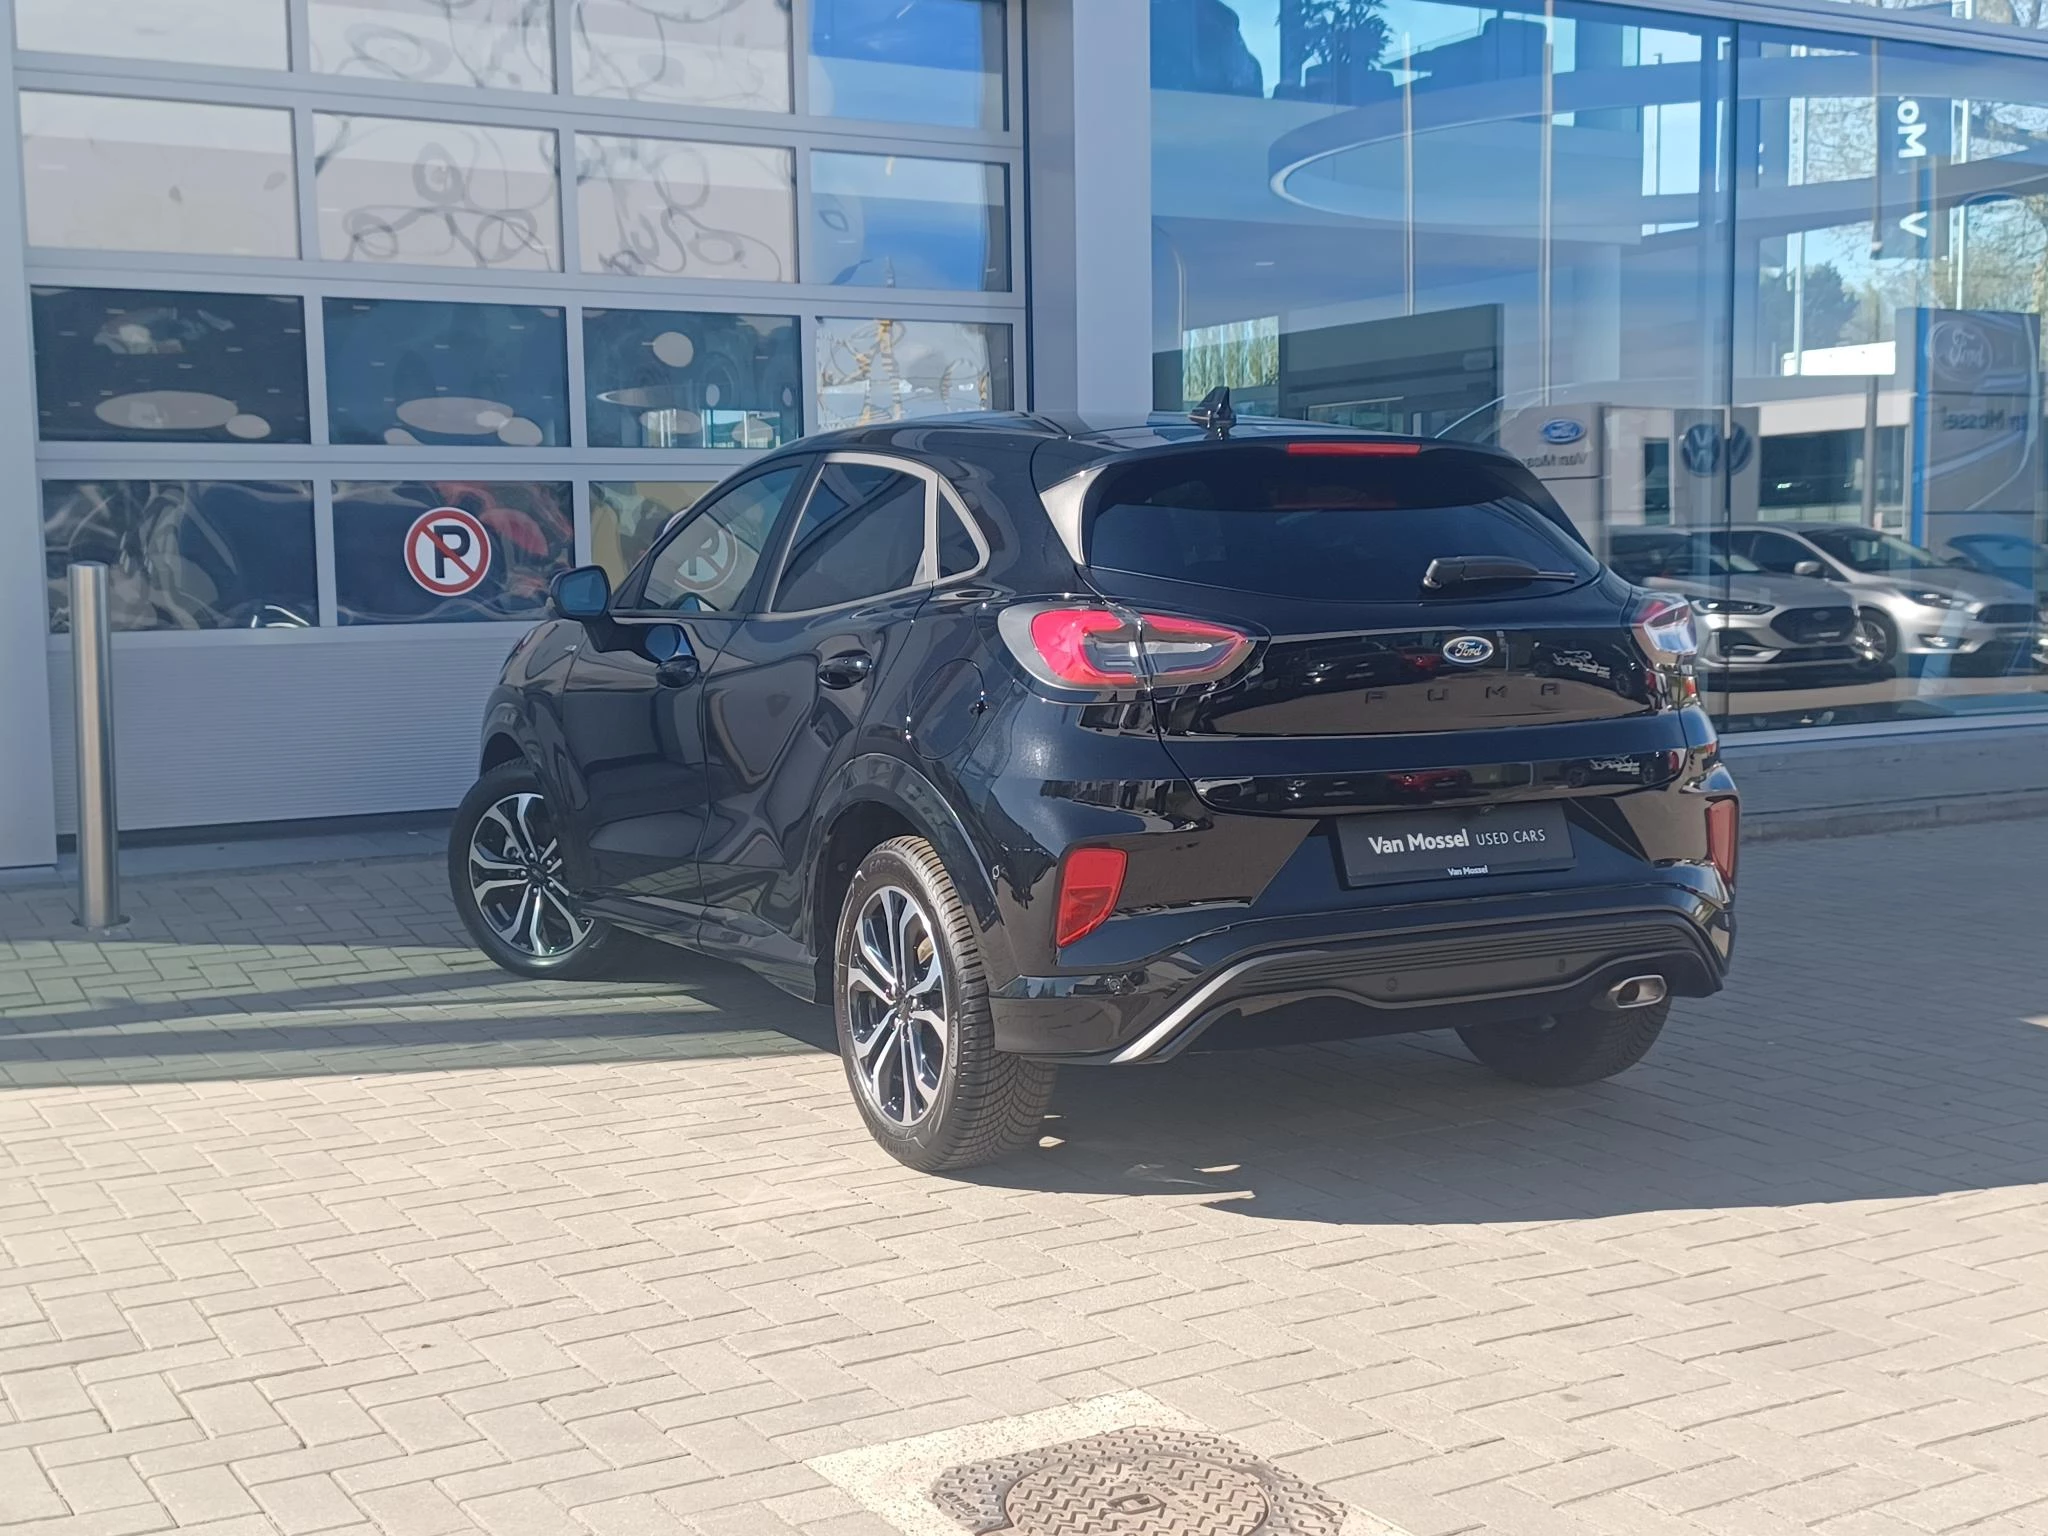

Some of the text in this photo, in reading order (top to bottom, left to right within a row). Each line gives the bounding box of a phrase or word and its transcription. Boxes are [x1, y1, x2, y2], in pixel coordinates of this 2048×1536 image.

[1455, 641, 1482, 657] Ford
[1365, 682, 1561, 704] PUMA
[1368, 828, 1546, 855] Van Mossel USED CARS
[1447, 865, 1489, 877] Van Mossel
